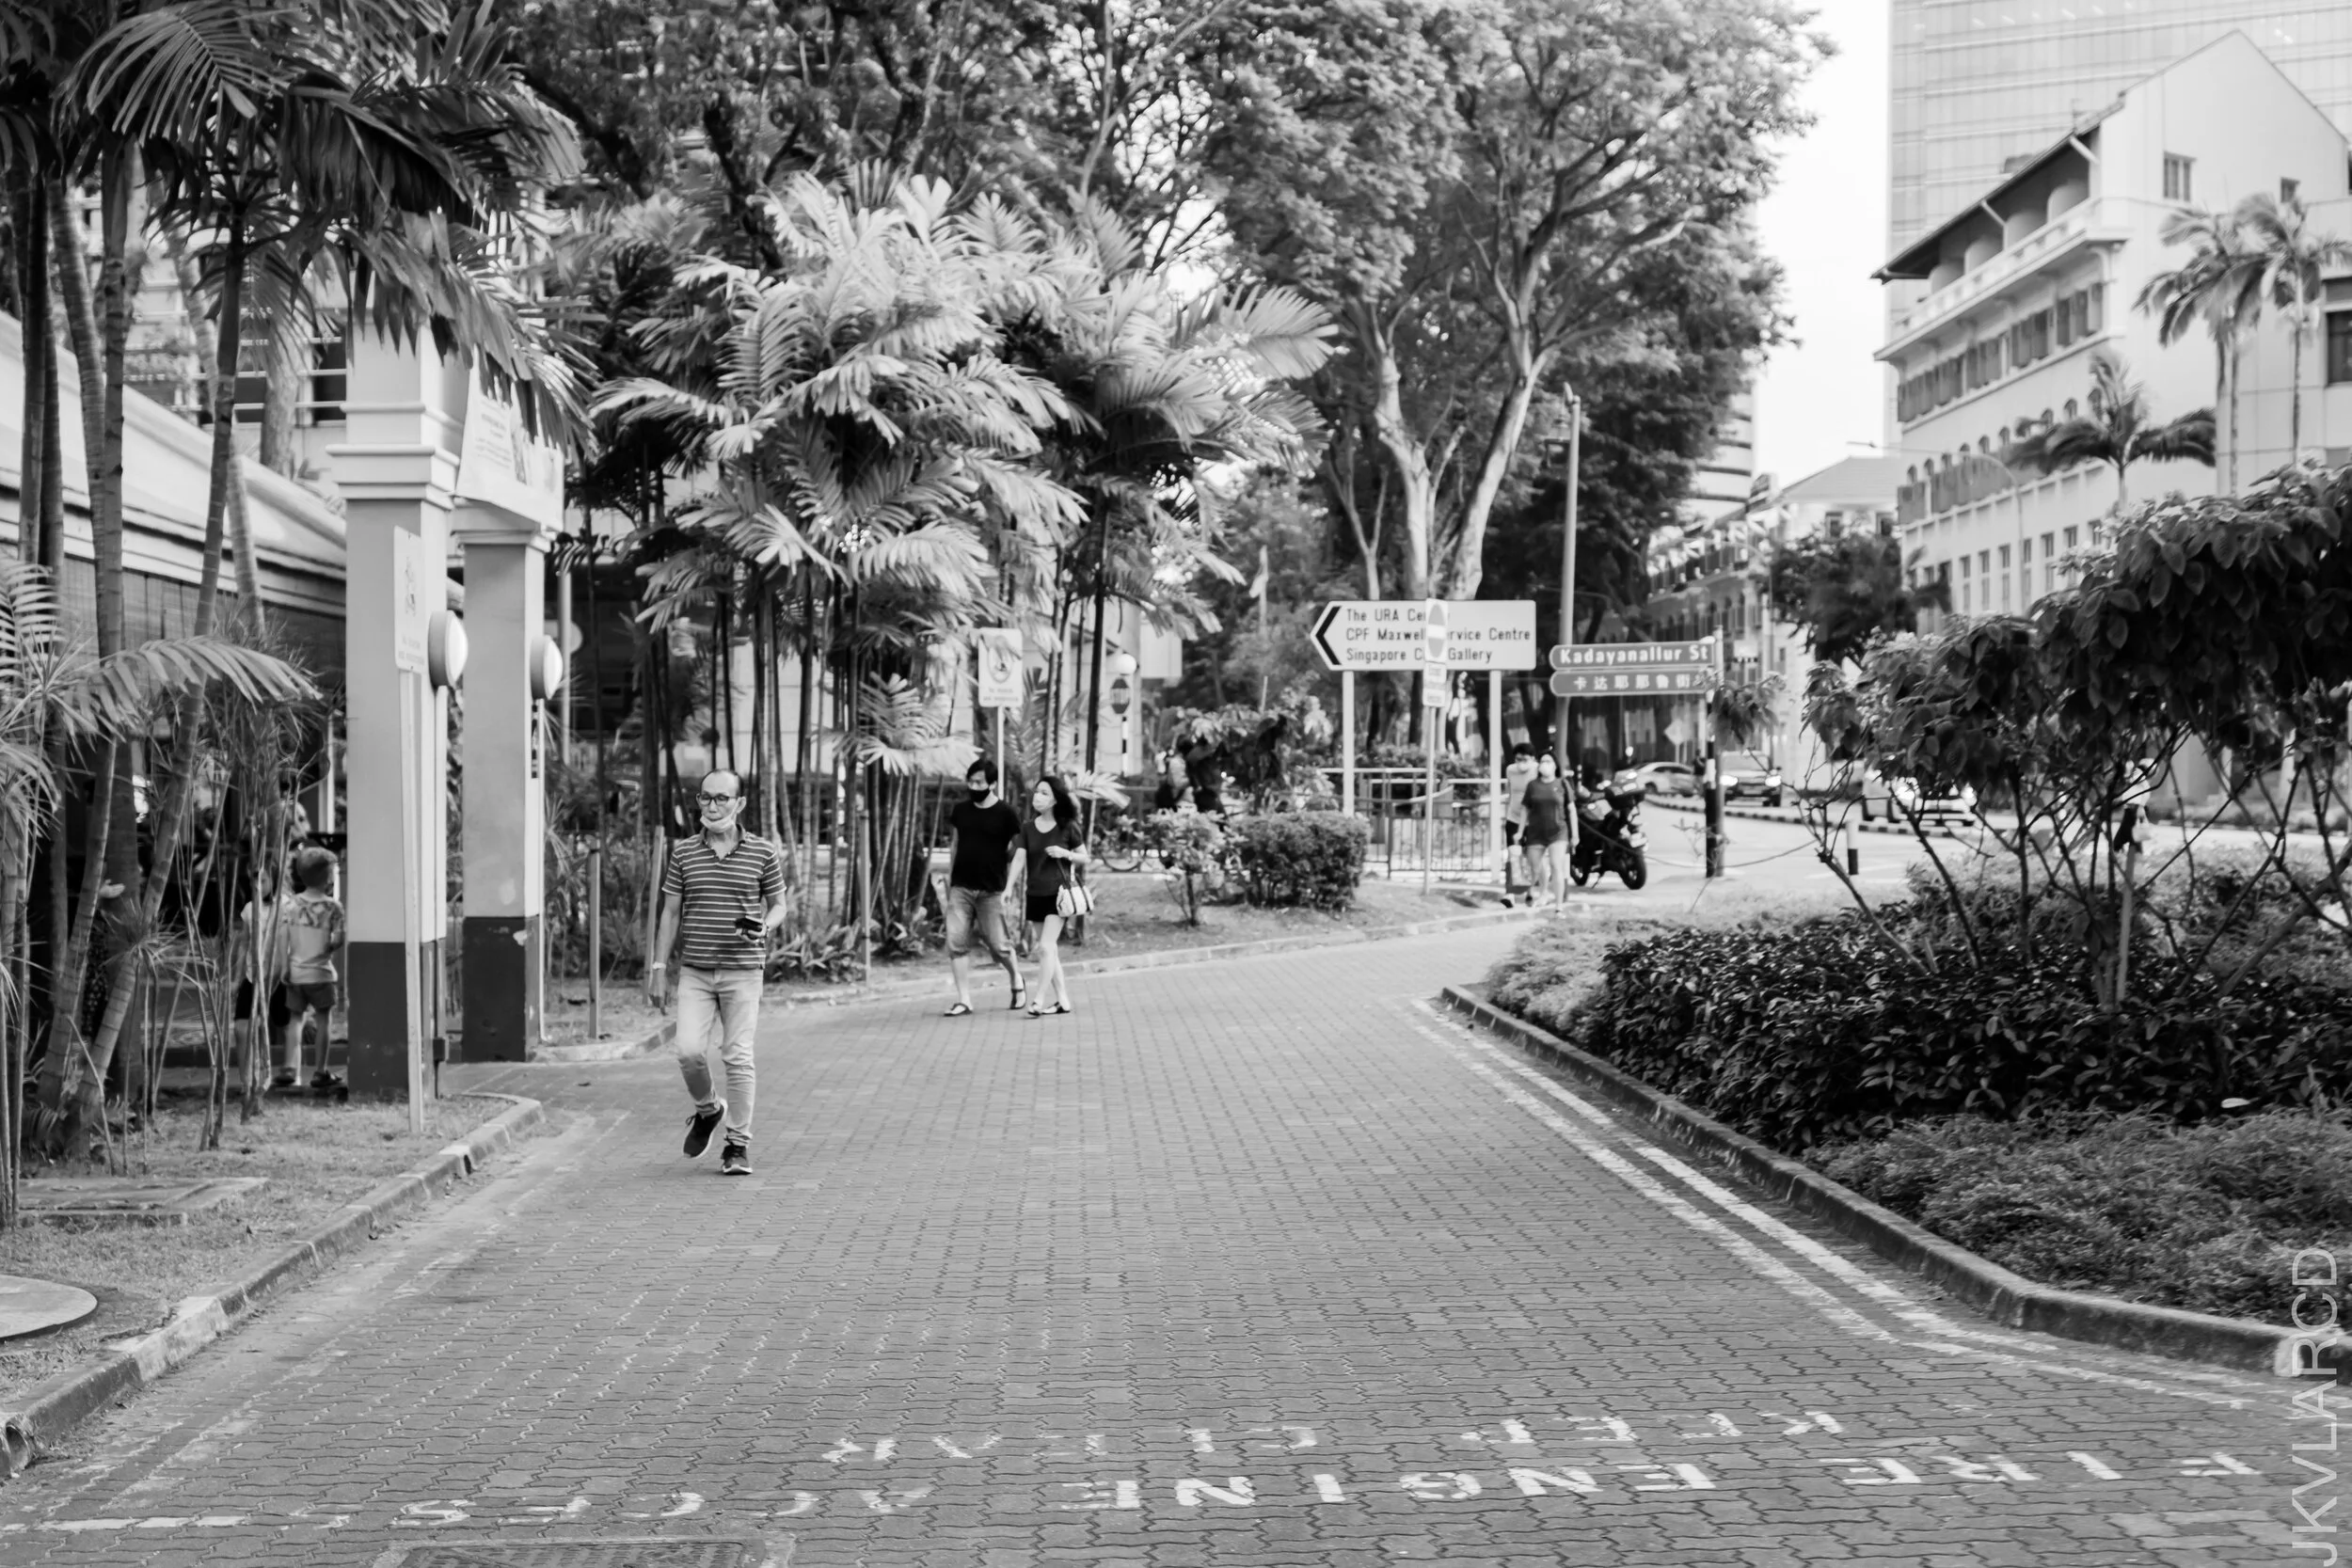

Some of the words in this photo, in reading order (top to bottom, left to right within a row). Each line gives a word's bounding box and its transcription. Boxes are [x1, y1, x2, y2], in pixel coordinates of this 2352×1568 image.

[1347, 609, 1367, 621] The
[1375, 609, 1400, 621] URA
[1346, 627, 1369, 641] CPF
[1447, 627, 1482, 641] rvice
[1488, 627, 1531, 641] Centre
[1346, 647, 1406, 664] Singapore
[1448, 647, 1493, 664] Gallery
[1560, 645, 1682, 666] Kadayanallur
[1689, 643, 1708, 660] St
[1819, 1451, 2261, 1484] FIRE
[1060, 1462, 1717, 1510] ENGINE
